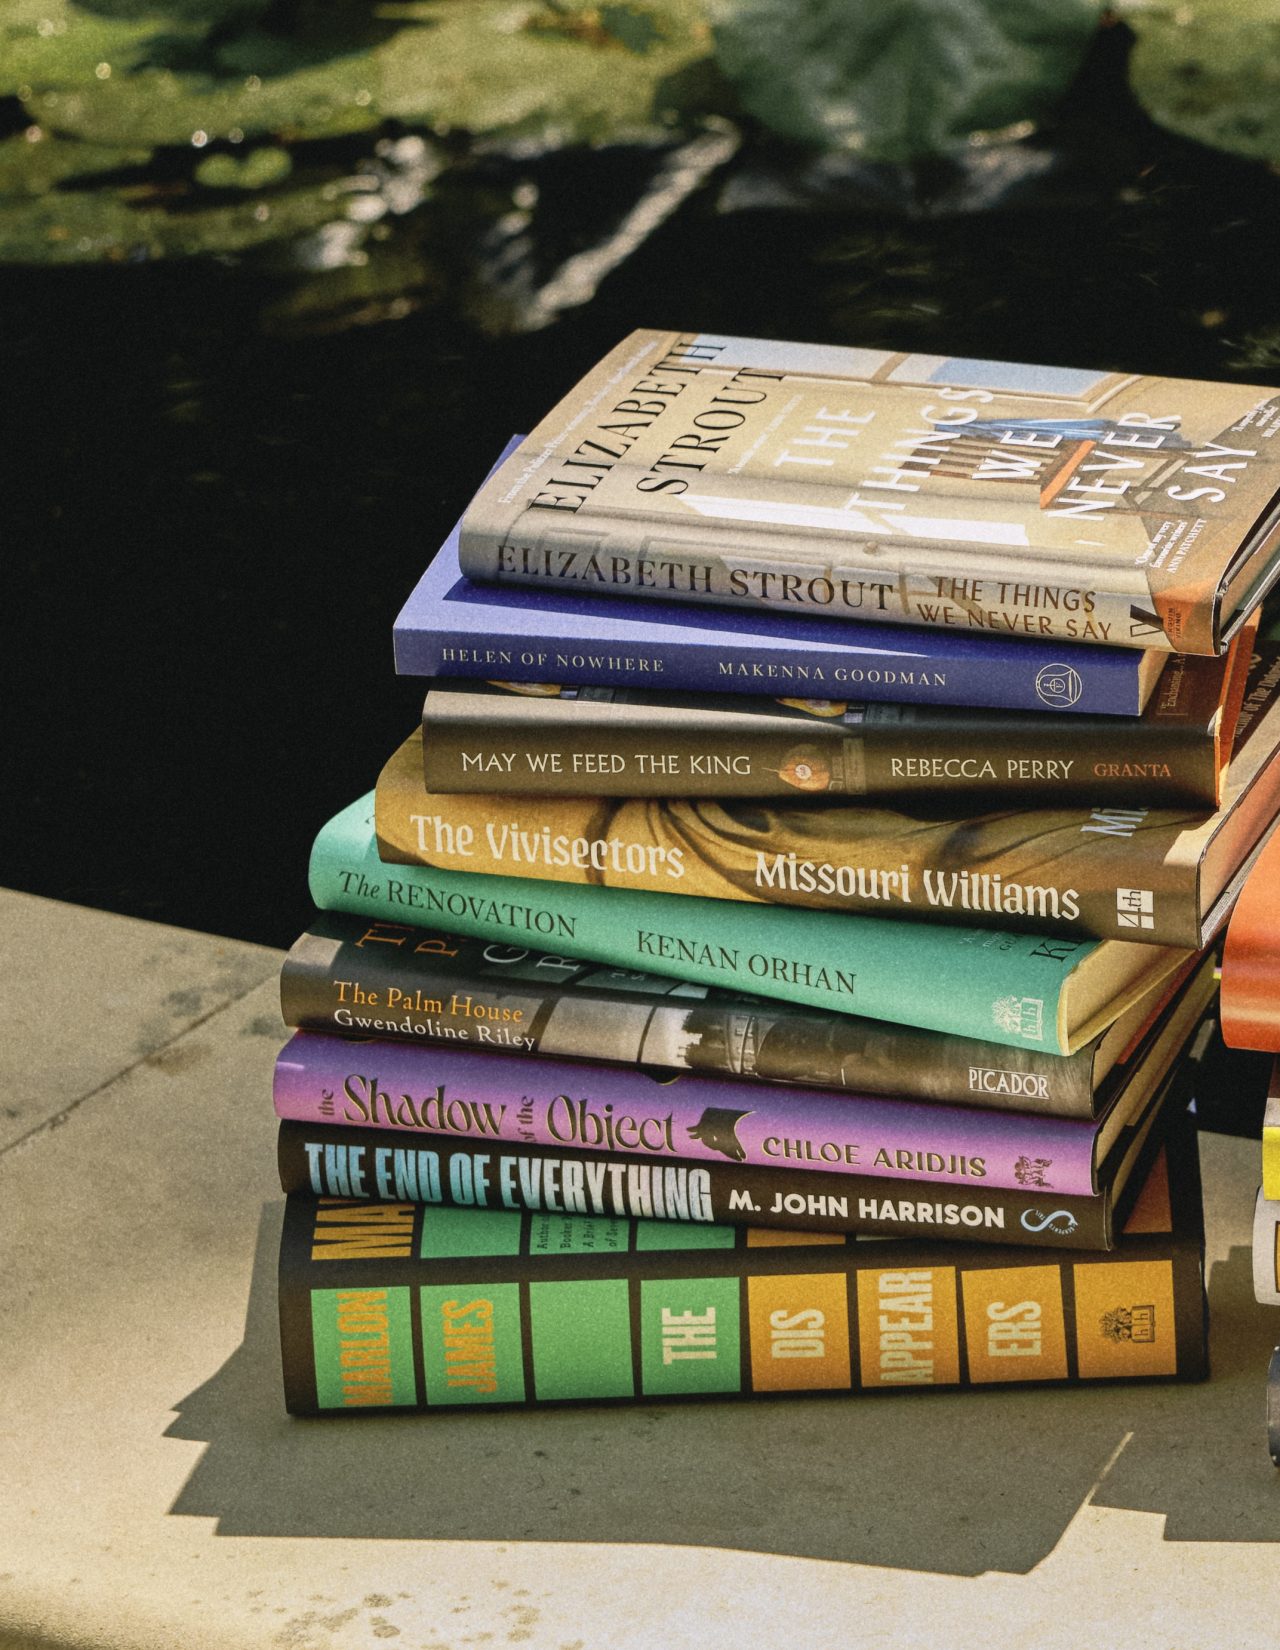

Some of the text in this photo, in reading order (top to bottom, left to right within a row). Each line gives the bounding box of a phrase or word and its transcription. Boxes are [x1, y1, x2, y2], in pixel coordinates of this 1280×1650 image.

[529, 343, 727, 514] ELIZABETH
[636, 367, 786, 495] STROUT
[775, 407, 877, 467] THE
[842, 387, 994, 514] THINGS
[972, 430, 1063, 481] WE
[1044, 412, 1182, 522] NEVER
[1167, 442, 1258, 503] SAY
[497, 544, 894, 611] ELIZABETH STROUT
[936, 576, 1097, 614] THE THINGS
[917, 603, 1112, 641] WE NEVER SAY
[441, 648, 947, 687] HELEN OF NOWHERE MAKENNA GOODMAN
[461, 752, 1172, 780] MAY WE FEED THE KING REBECCA PERRY GRANTA
[410, 814, 1081, 922] The Vivisectors Missouri Williams
[338, 871, 383, 899] The
[386, 880, 579, 939] RENOVATION
[637, 930, 741, 971] KENAN
[748, 954, 858, 996] ORHAN
[333, 980, 525, 1023] The Palm House
[333, 1008, 536, 1051] Gwendoline Riley
[968, 1068, 1050, 1098] PICADOR
[318, 1089, 335, 1116] the
[343, 1074, 507, 1136] Shadow
[516, 1095, 535, 1125] the
[546, 1094, 679, 1154] Object
[761, 1137, 862, 1166] CHLOE
[872, 1147, 987, 1177] ARIDJIS
[304, 1142, 370, 1199] THE
[375, 1148, 443, 1202] END
[449, 1153, 494, 1206] OF
[499, 1156, 715, 1223] EVERYTHING
[728, 1189, 762, 1213] M.
[770, 1192, 849, 1218] JOHN
[858, 1198, 1006, 1229] HARRISON
[336, 1290, 394, 1406] MARLON
[441, 1298, 497, 1393] JAMES
[661, 1306, 717, 1366] THE
[770, 1308, 825, 1359] DIS
[878, 1270, 934, 1383] APPEAR
[986, 1300, 1042, 1358] ERS
